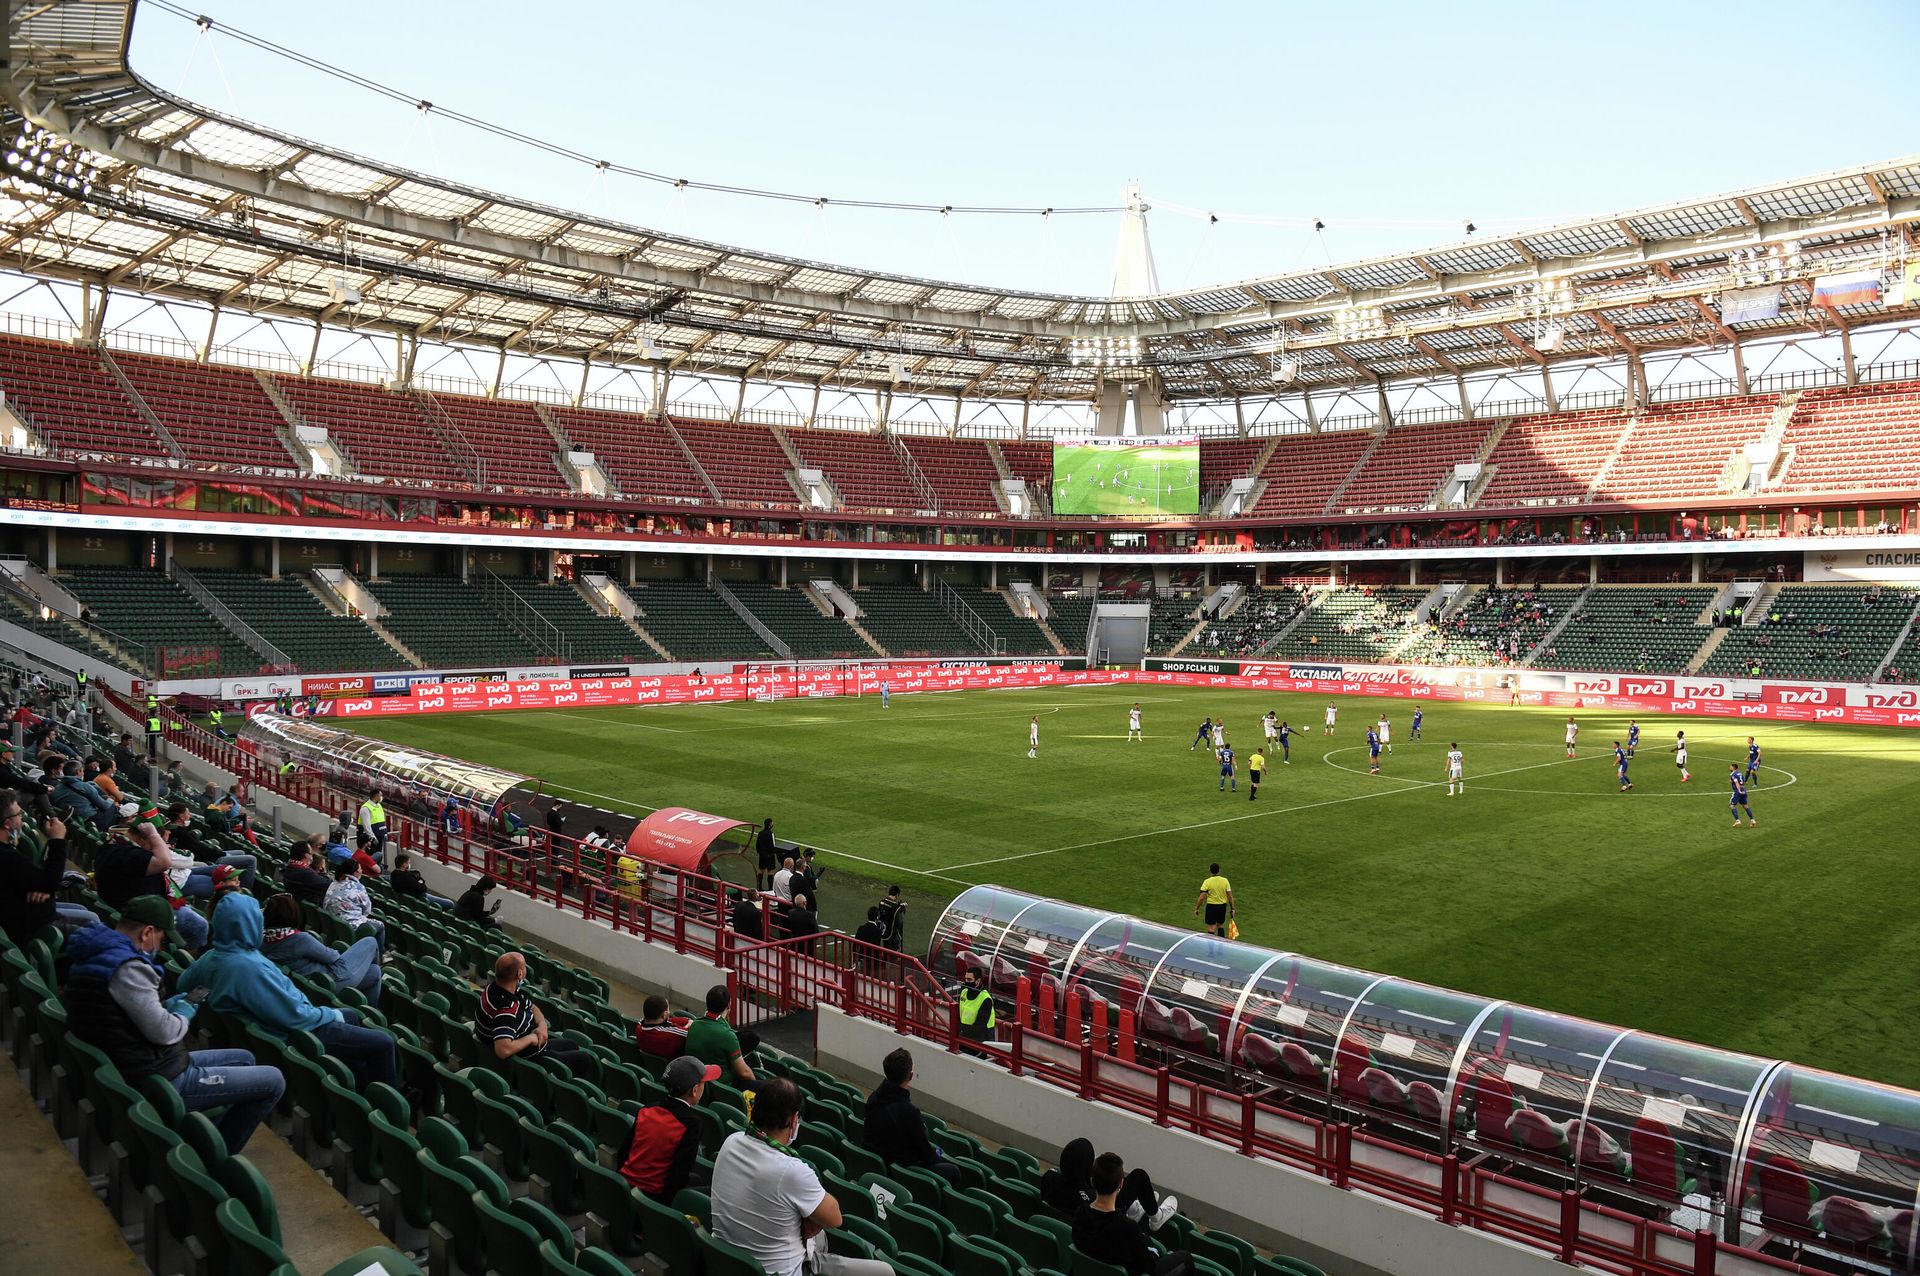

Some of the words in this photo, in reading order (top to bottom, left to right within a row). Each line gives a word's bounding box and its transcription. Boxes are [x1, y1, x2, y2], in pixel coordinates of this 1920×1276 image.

[1162, 662, 1220, 673] SHOP.FCLM.RU
[444, 674, 505, 684] SPORT24.RU
[308, 682, 334, 691] НИИАС
[1453, 756, 1460, 764] 59
